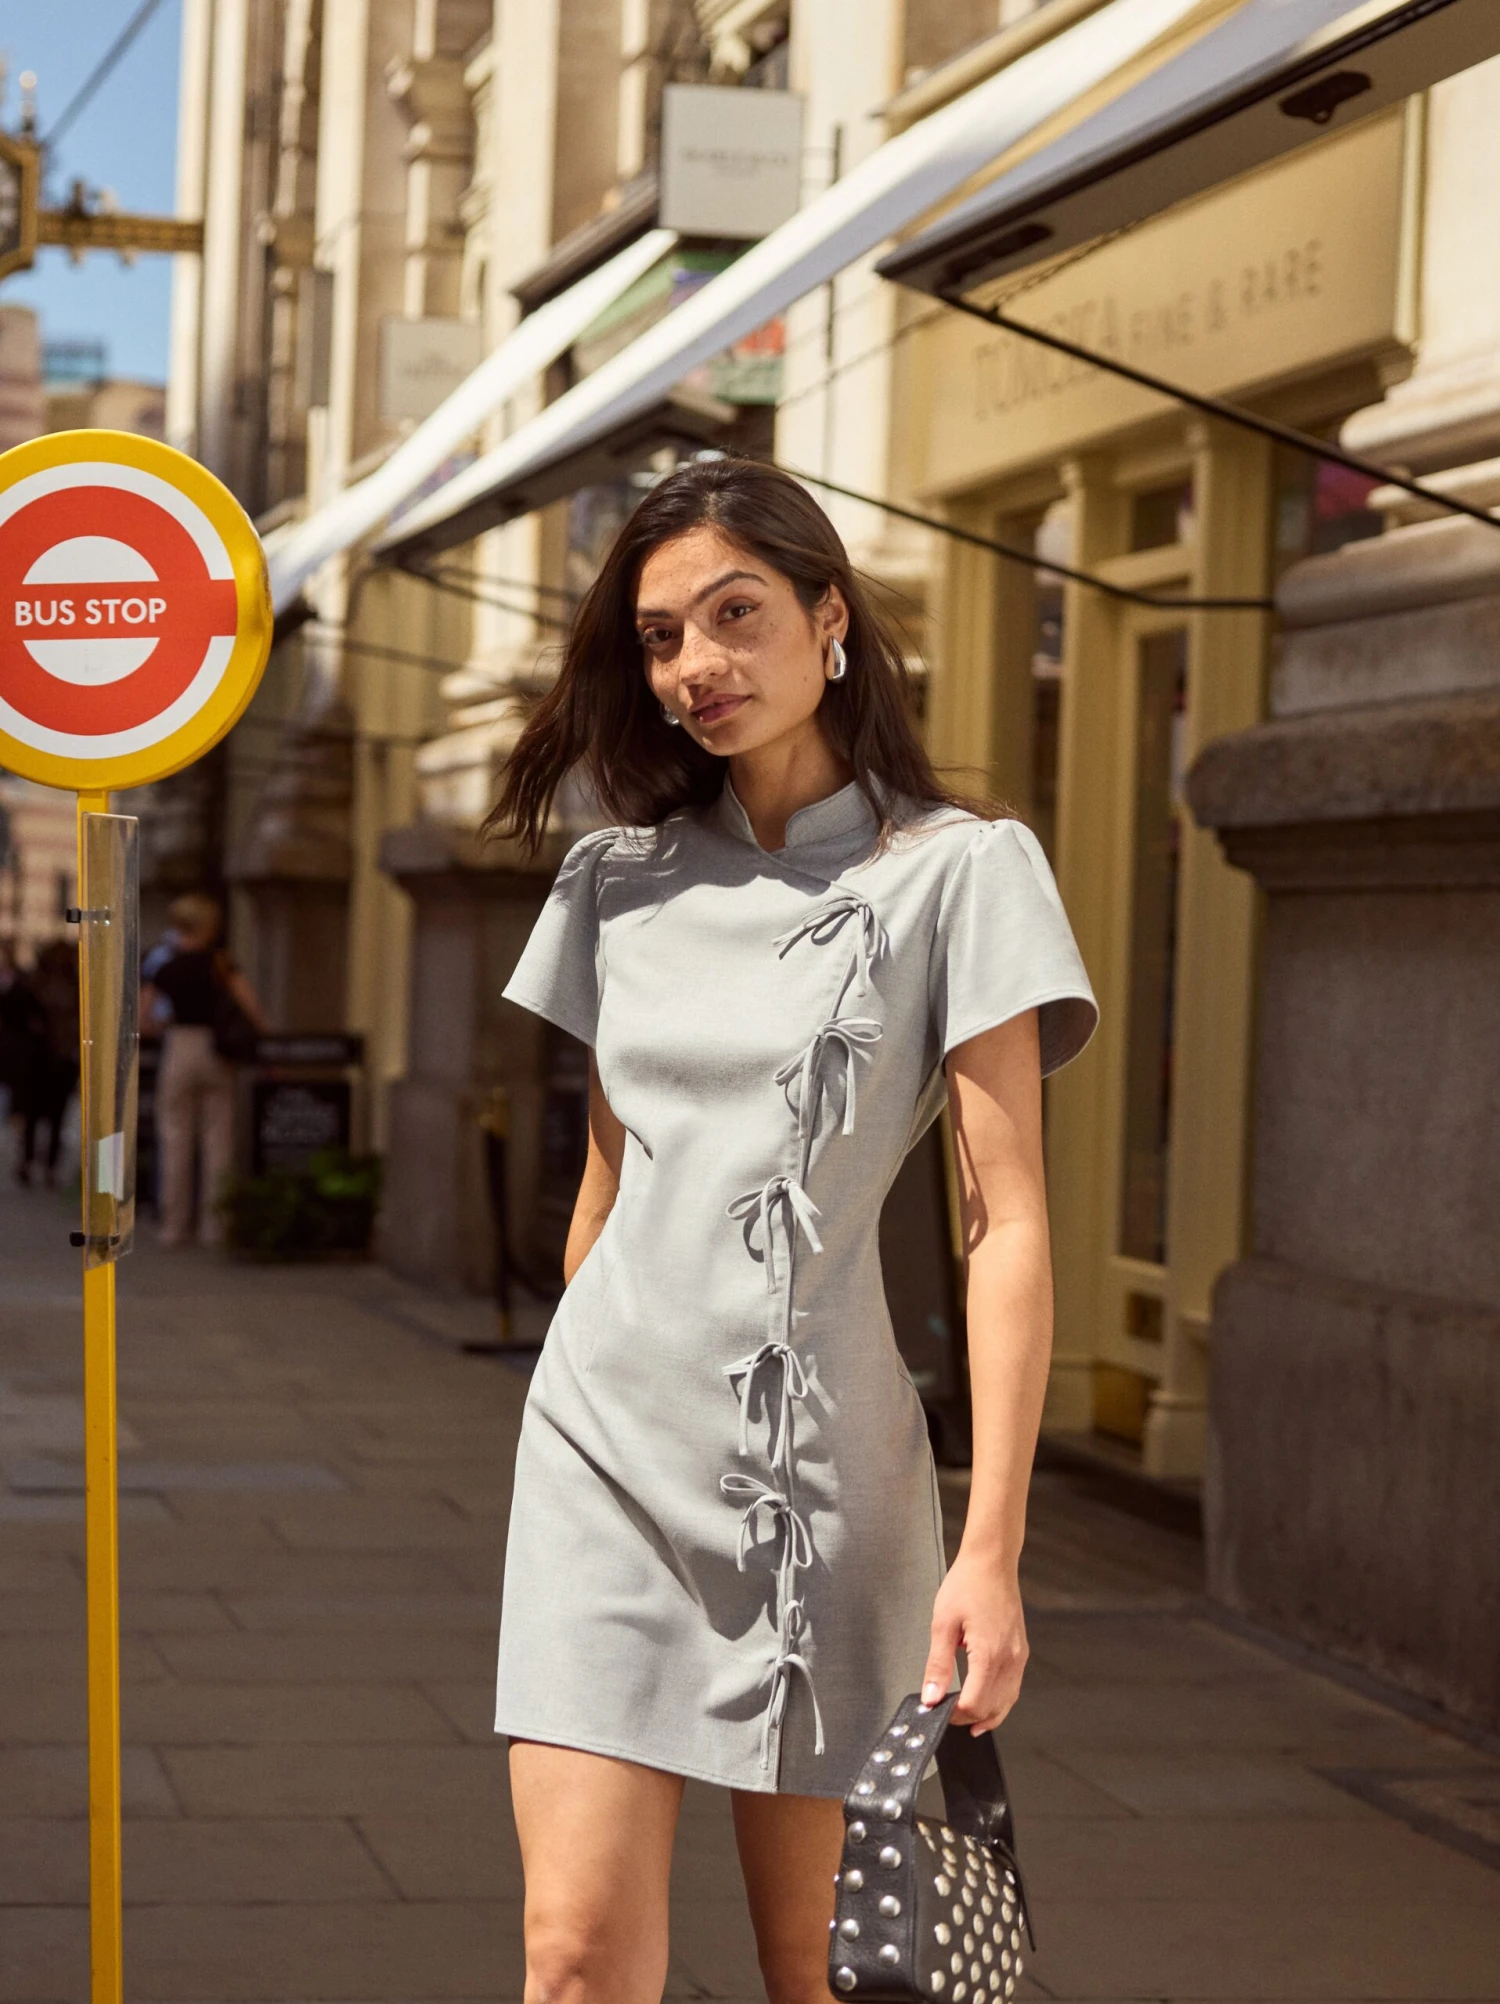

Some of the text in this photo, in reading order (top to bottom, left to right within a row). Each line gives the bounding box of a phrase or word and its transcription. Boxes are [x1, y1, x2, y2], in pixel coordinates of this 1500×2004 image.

[1239, 236, 1324, 318] RARE
[15, 597, 167, 626] BUS STOP
